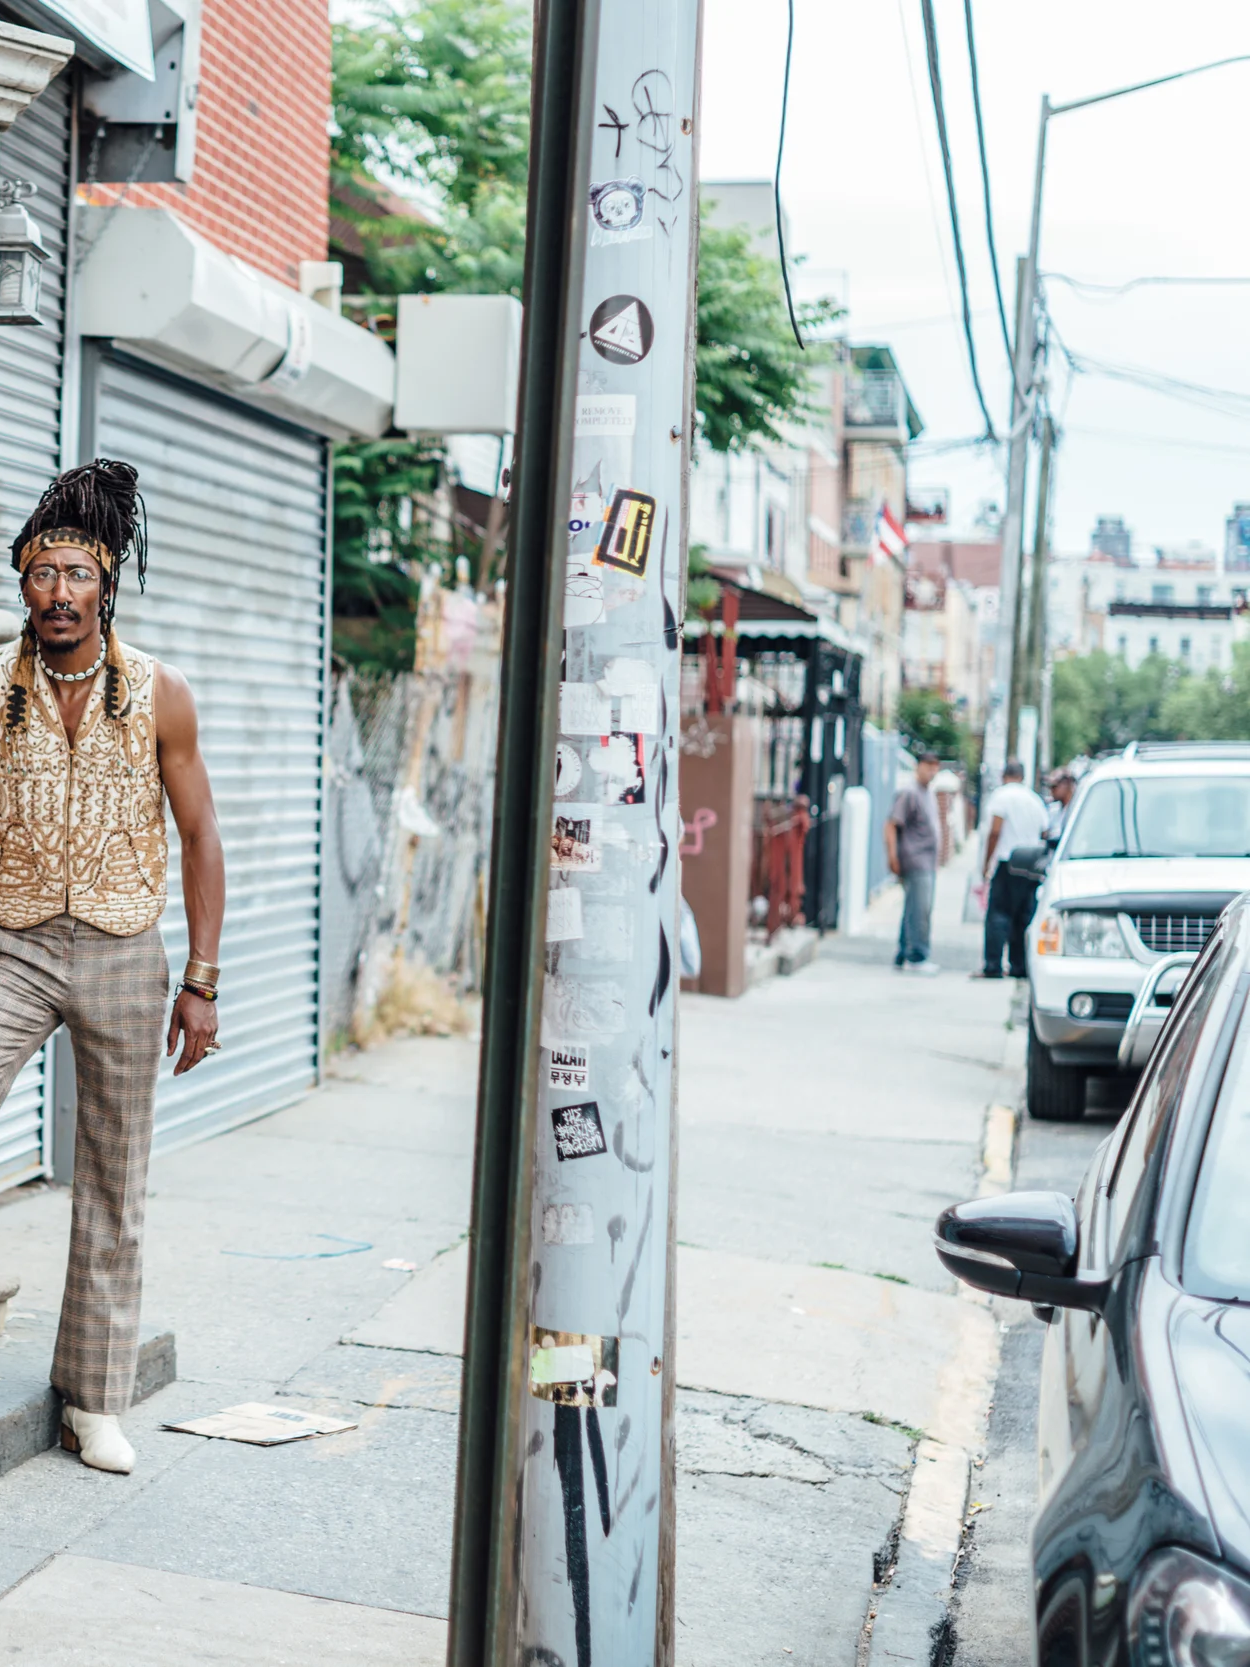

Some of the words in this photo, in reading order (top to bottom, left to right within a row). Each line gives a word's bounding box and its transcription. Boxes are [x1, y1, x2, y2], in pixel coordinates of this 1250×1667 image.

[581, 406, 624, 416] REMOVE
[575, 416, 635, 425] OMPLETELY
[550, 1071, 587, 1086] 무정부
